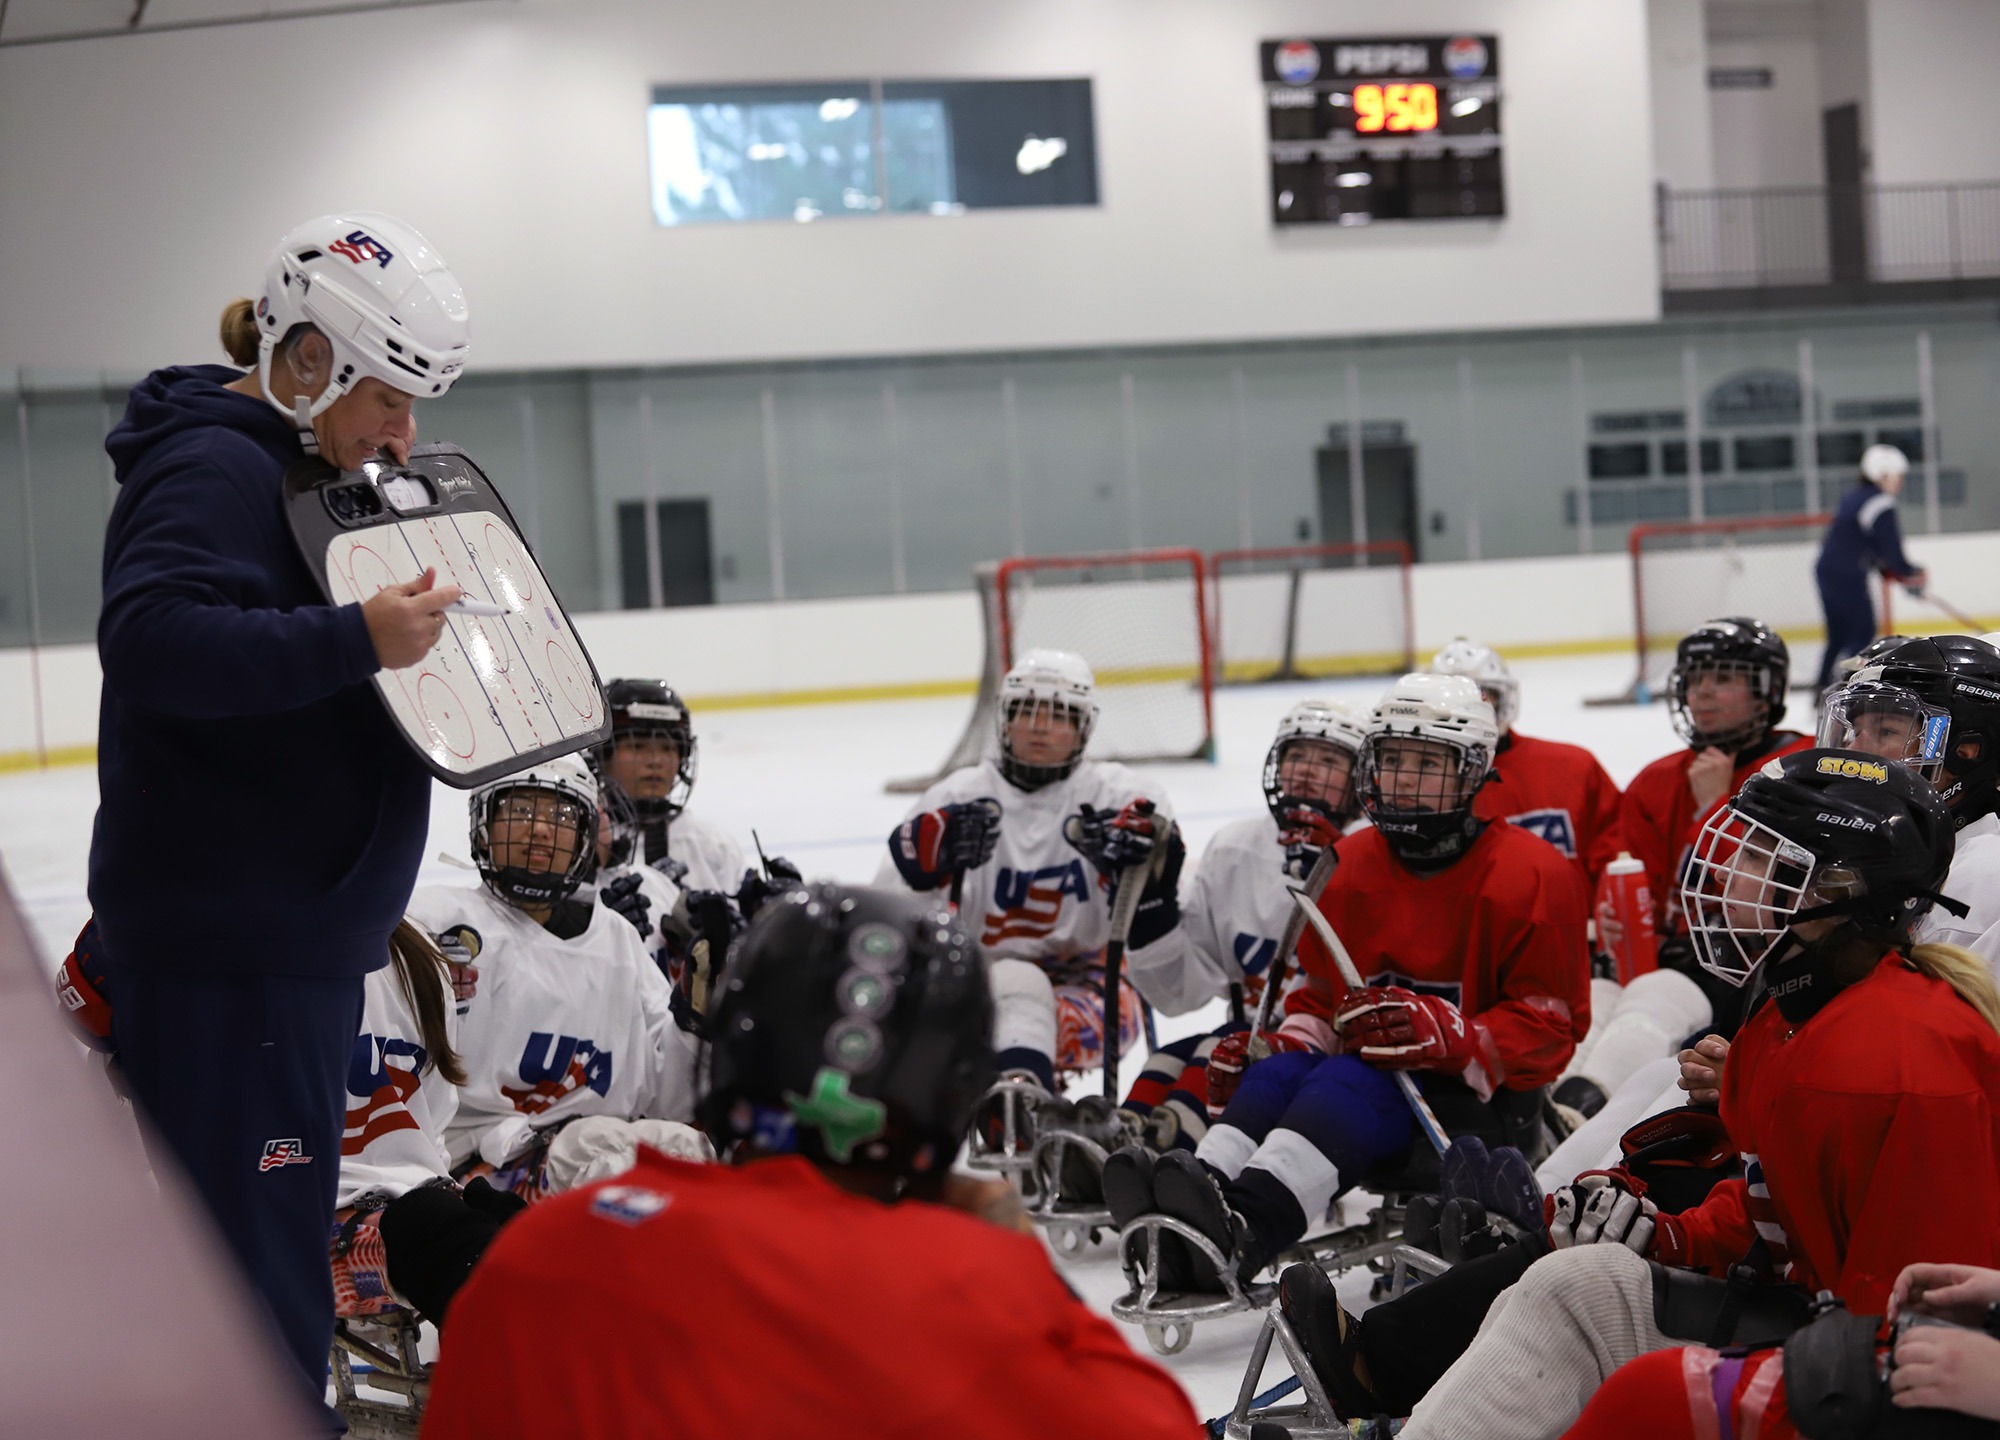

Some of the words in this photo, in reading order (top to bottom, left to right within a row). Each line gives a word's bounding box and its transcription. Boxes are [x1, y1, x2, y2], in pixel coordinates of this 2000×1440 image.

[329, 230, 394, 269] USA
[1956, 683, 2000, 700] BAUER
[1925, 716, 1943, 758] BAUER
[1816, 756, 1888, 785] STORM
[1816, 812, 1876, 832] BAUER
[986, 859, 1089, 930] USA
[1767, 974, 1813, 998] AUER
[512, 1031, 612, 1106] USA
[261, 1138, 302, 1169] USA
